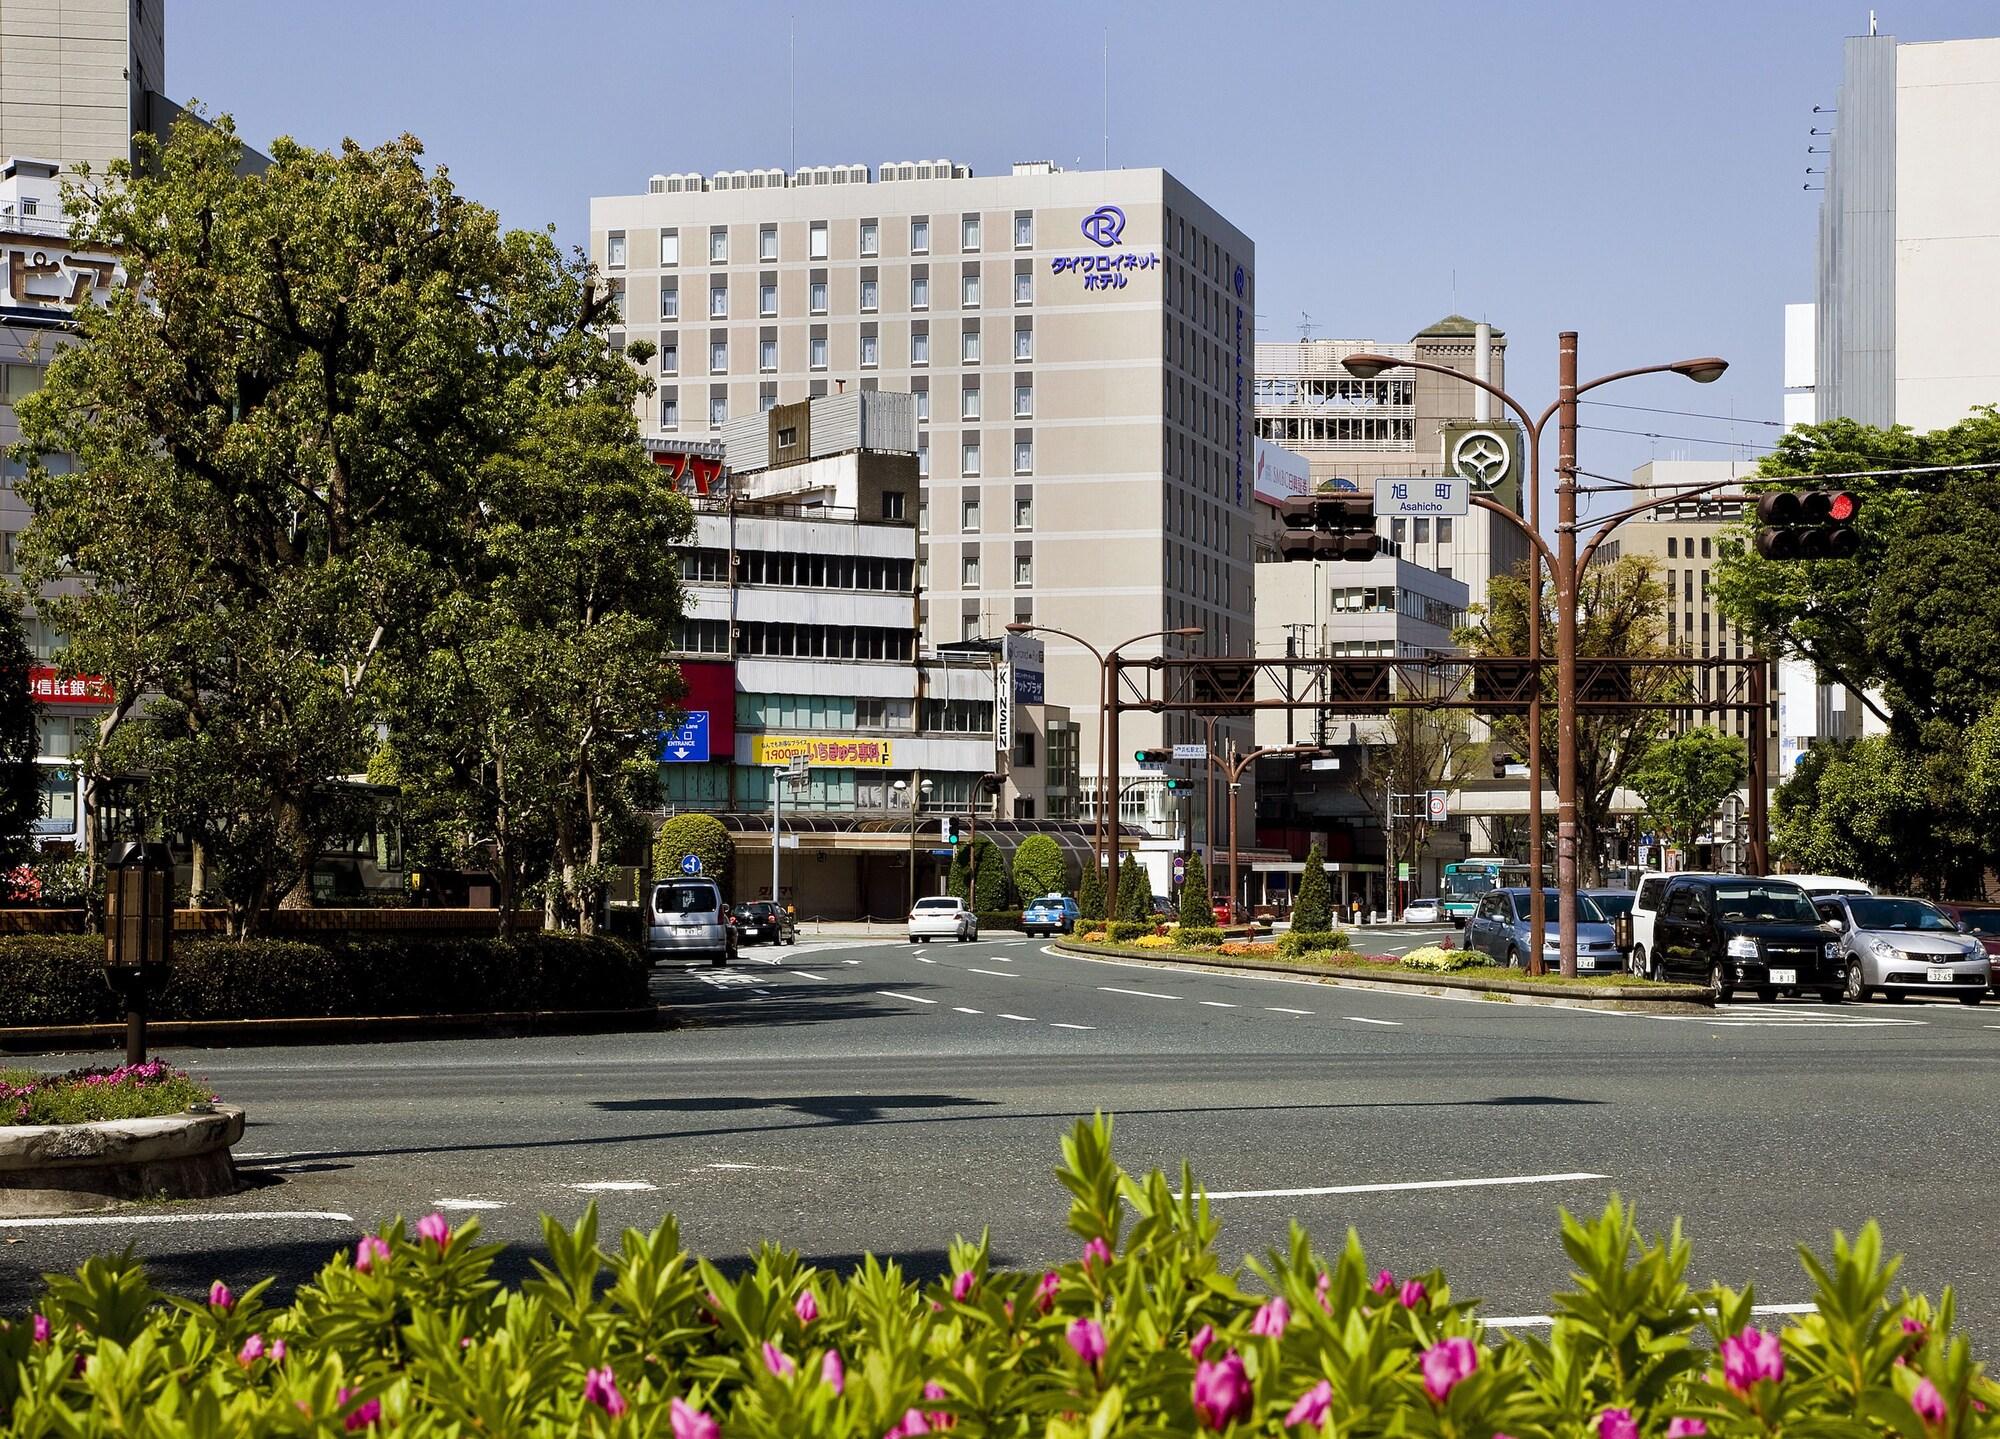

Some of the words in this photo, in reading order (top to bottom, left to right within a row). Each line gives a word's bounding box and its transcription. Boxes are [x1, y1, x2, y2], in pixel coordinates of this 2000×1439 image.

[1051, 252, 1161, 275] ダイワロイネット
[1083, 272, 1128, 291] ホテル
[1391, 483, 1452, 500] 旭町
[1400, 502, 1443, 511] Asahicho
[999, 671, 1007, 749] KINSEN
[1432, 802, 1441, 810] 40
